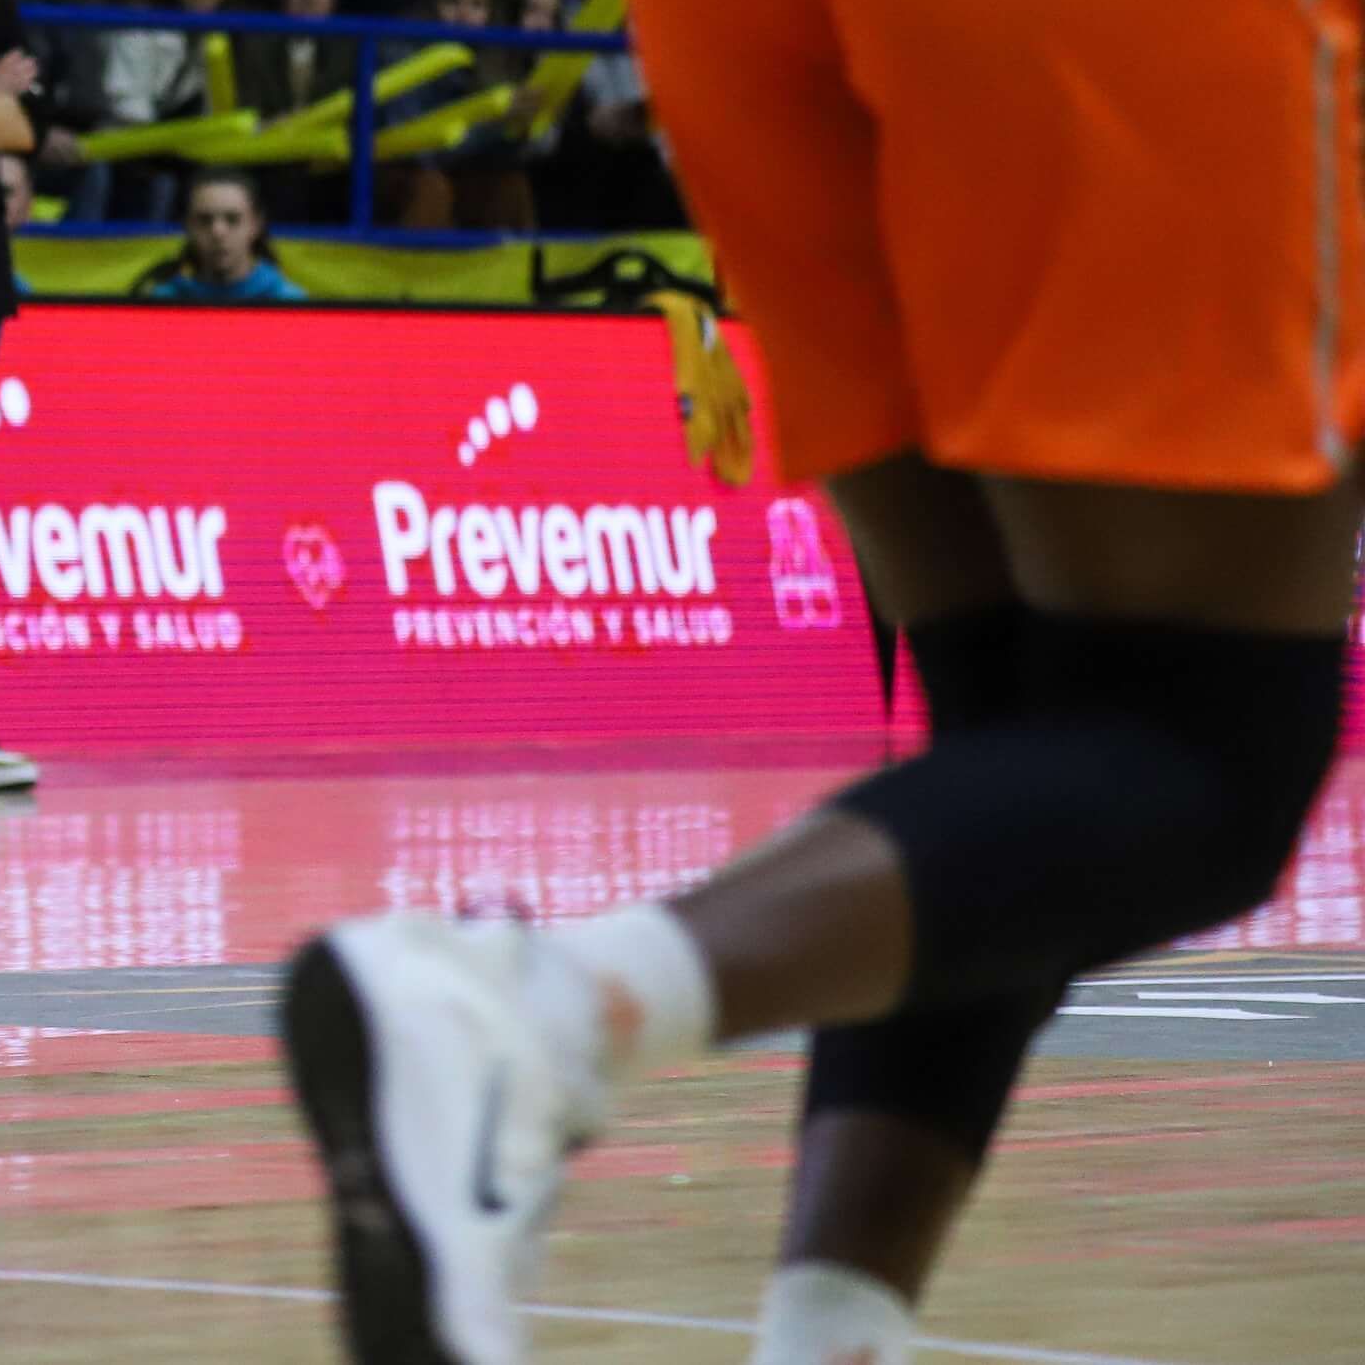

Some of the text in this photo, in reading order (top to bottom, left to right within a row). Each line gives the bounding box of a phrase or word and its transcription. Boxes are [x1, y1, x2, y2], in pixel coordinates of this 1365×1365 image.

[373, 480, 717, 598] Prevemur
[100, 612, 121, 649] Y
[132, 611, 243, 652] SALUD
[392, 602, 733, 648] PREVENCIÓN Y SALUD
